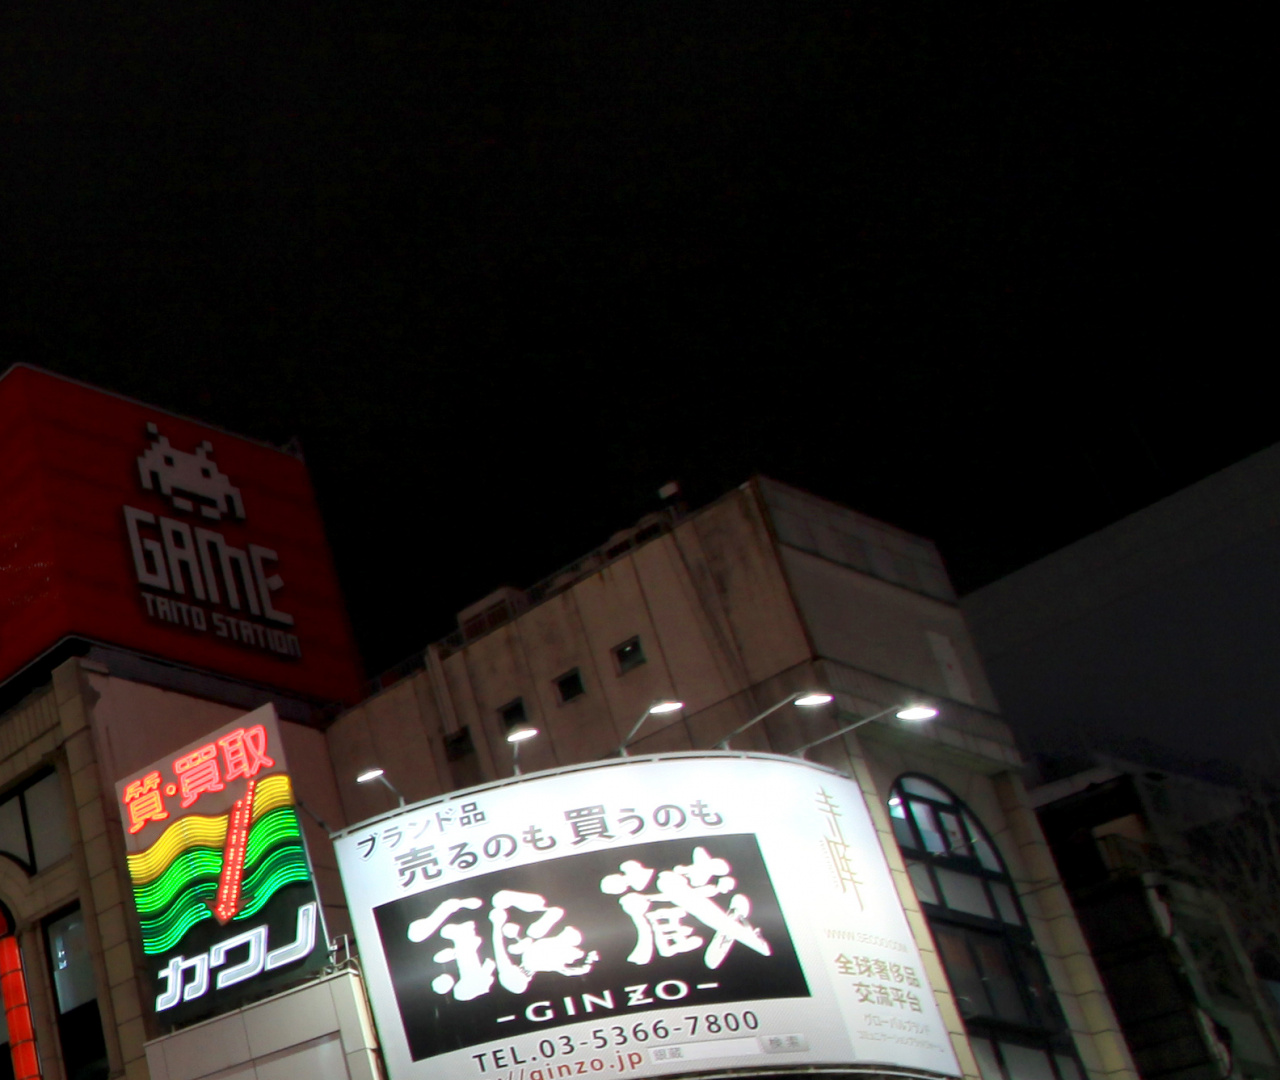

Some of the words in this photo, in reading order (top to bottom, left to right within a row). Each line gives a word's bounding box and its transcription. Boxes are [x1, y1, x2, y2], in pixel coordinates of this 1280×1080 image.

[122, 503, 295, 626] GAME
[140, 591, 208, 634] TAITO
[209, 611, 302, 659] STATION
[122, 724, 275, 835] 質・買取
[356, 801, 487, 860] ブランド品
[154, 900, 318, 1012] カワノ
[407, 845, 773, 1001] 銀蔵
[833, 951, 922, 990] 全球奢侈品
[852, 980, 923, 1016] 交流平台
[472, 1010, 761, 1075] TEL.03-5366-7800
